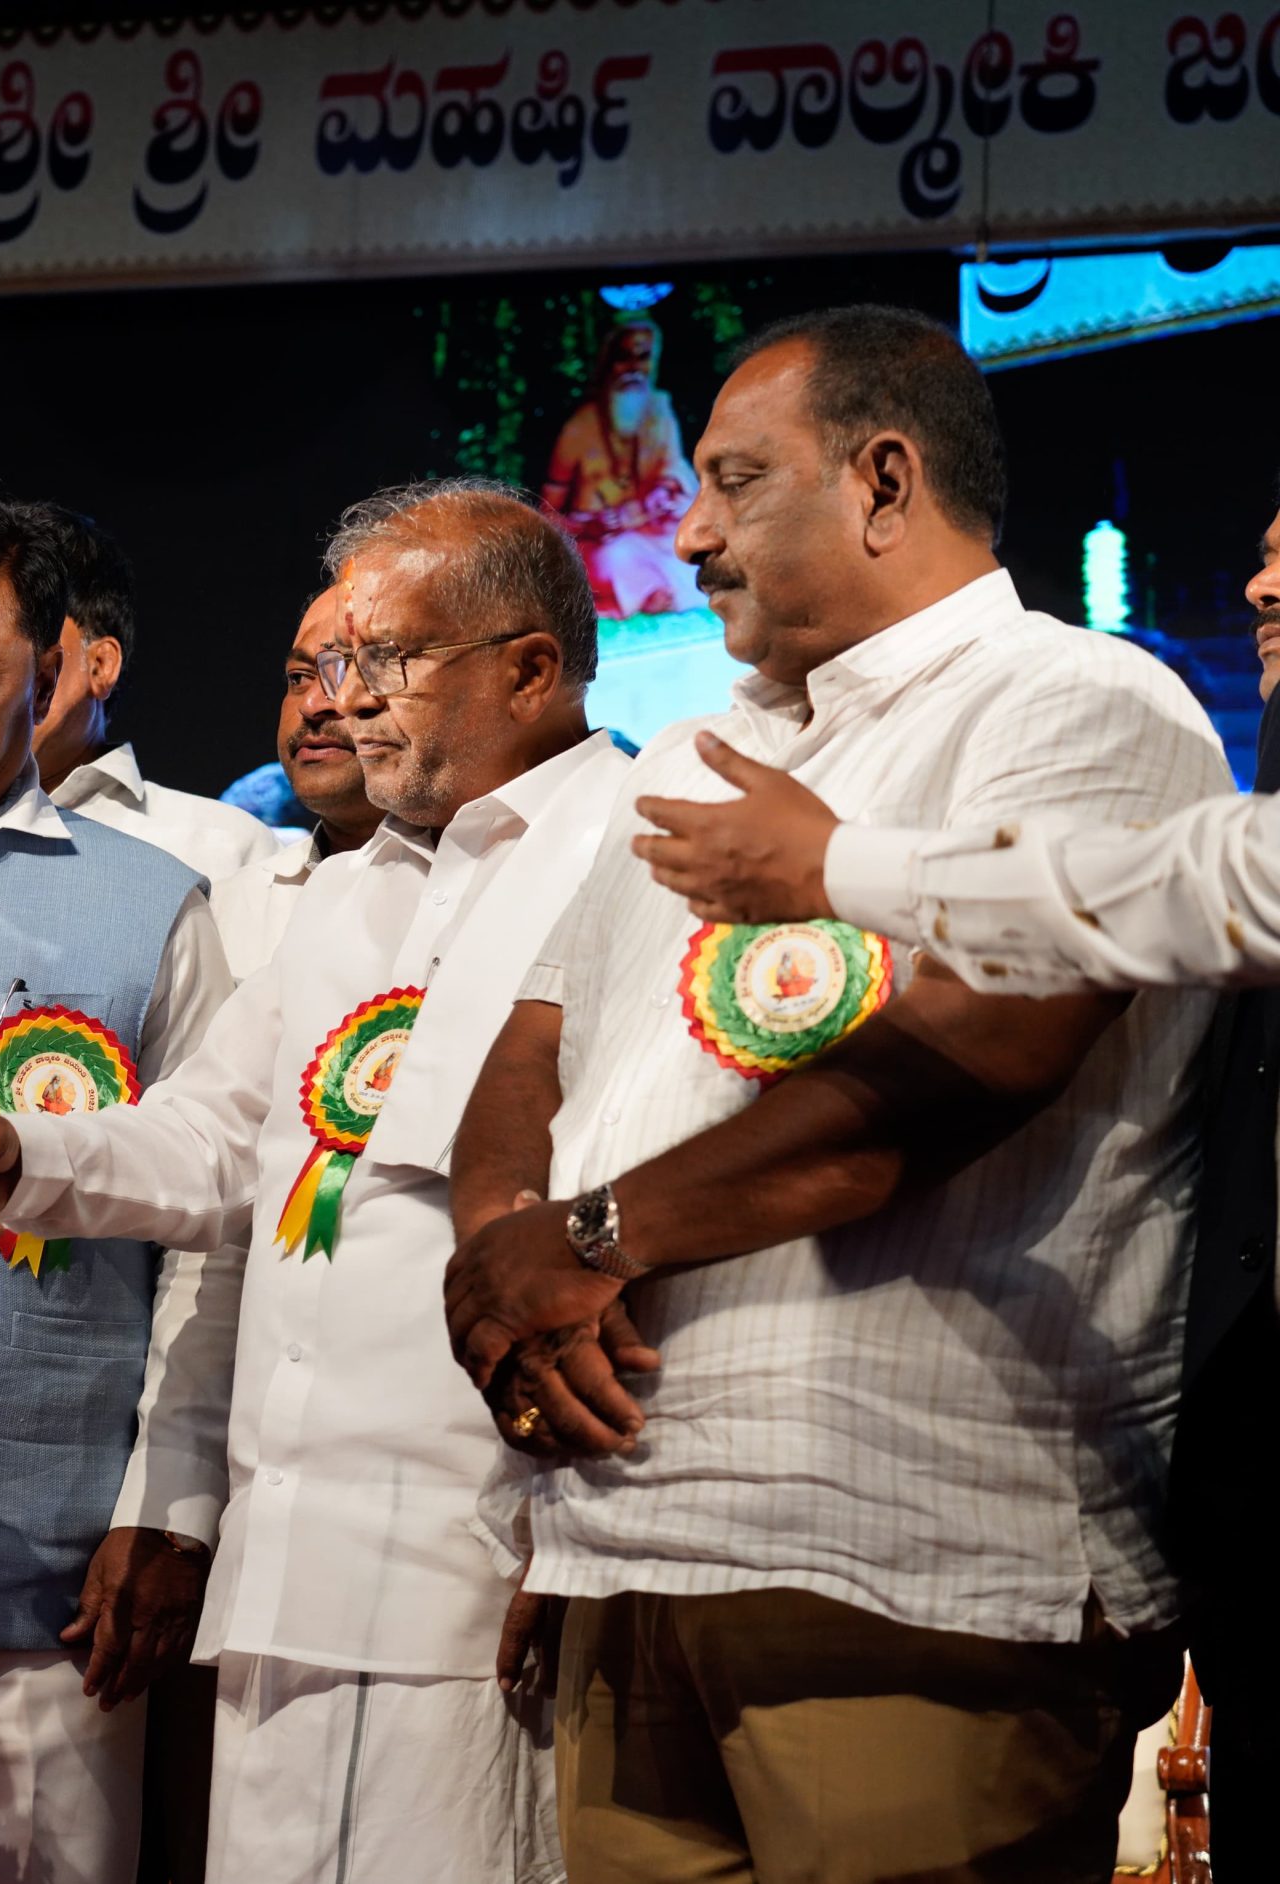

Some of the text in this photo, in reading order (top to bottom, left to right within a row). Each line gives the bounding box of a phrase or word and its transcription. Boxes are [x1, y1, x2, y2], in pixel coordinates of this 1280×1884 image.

[133, 48, 262, 234] ಶ್ರೀ
[316, 48, 652, 188] ಮಹರ್ಷಿ
[708, 14, 1100, 219] ವಾಲ್ಮೀಕಿ
